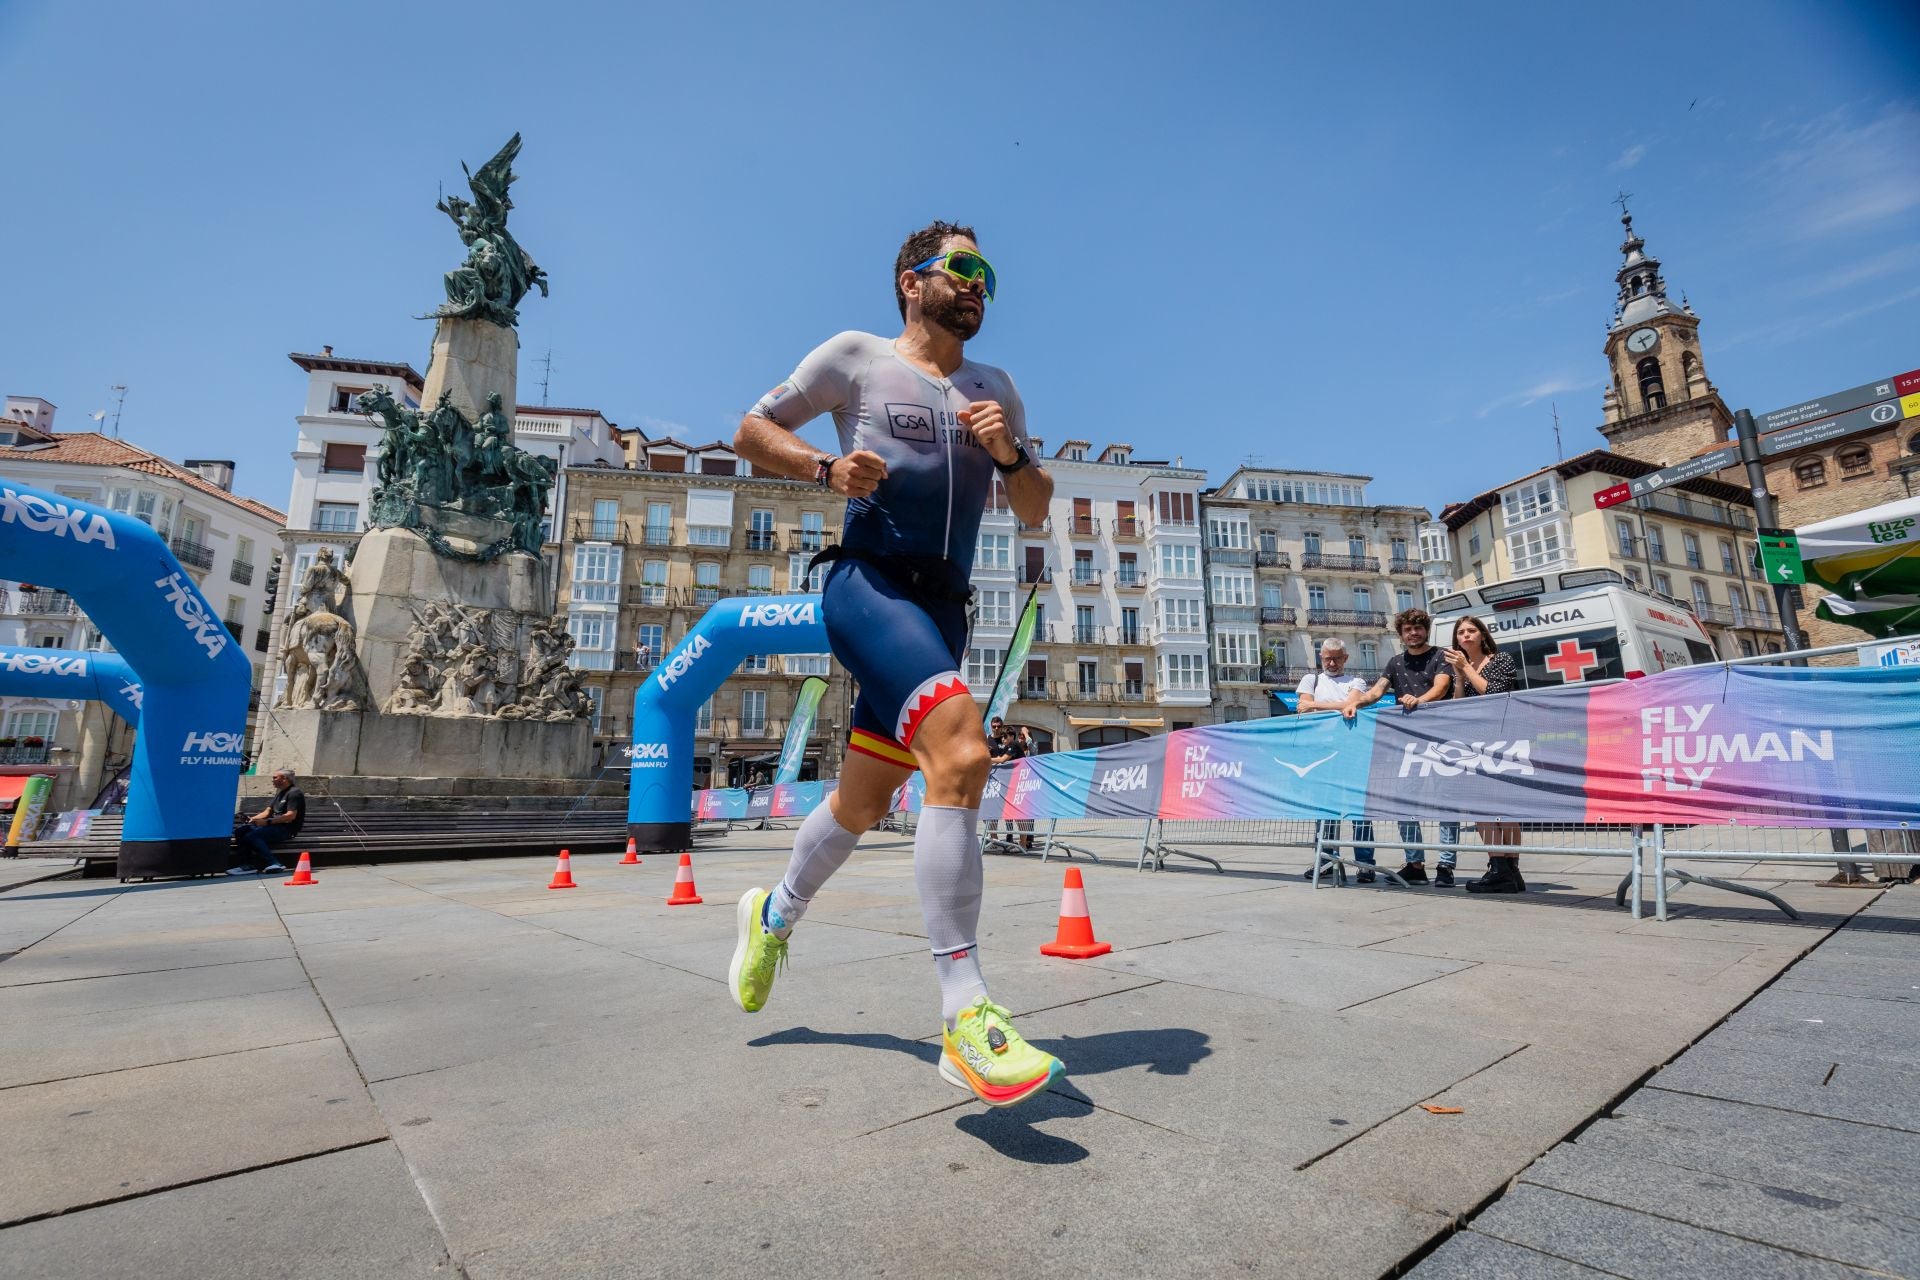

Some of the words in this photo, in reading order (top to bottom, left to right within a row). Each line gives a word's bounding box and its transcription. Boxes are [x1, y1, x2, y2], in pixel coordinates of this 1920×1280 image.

[1901, 379, 1912, 387] 15
[1767, 409, 1798, 421] Espainia
[1799, 403, 1820, 413] plaza
[1768, 419, 1789, 429] Plaza
[1800, 408, 1828, 420] España
[894, 414, 930, 432] GSA
[1773, 431, 1804, 443] Turismo
[1804, 422, 1836, 434] bulegoa
[1775, 439, 1802, 450] Oficina
[1814, 427, 1845, 439] Turismo
[1664, 474, 1685, 484] Museo
[1868, 517, 1916, 537] fuze
[1871, 529, 1908, 544] tea
[155, 571, 228, 660] HOKA
[739, 602, 816, 628] HOKA
[1488, 608, 1585, 634] BULANCIA
[657, 633, 713, 692] HOKA
[1641, 704, 1715, 734] FLY
[182, 732, 245, 753] HOK
[1642, 730, 1835, 765] HUMAN
[180, 756, 201, 765] FLY
[1184, 745, 1210, 763] FLY
[1398, 740, 1535, 778] HOKA
[1019, 768, 1031, 781] FLY
[1099, 763, 1149, 793] HOKA
[1183, 761, 1243, 781] HUMAN
[1016, 779, 1043, 793] HUMAN
[1181, 780, 1207, 799] FLY
[1012, 793, 1026, 806] FLY
[958, 1035, 995, 1079] HOKA
